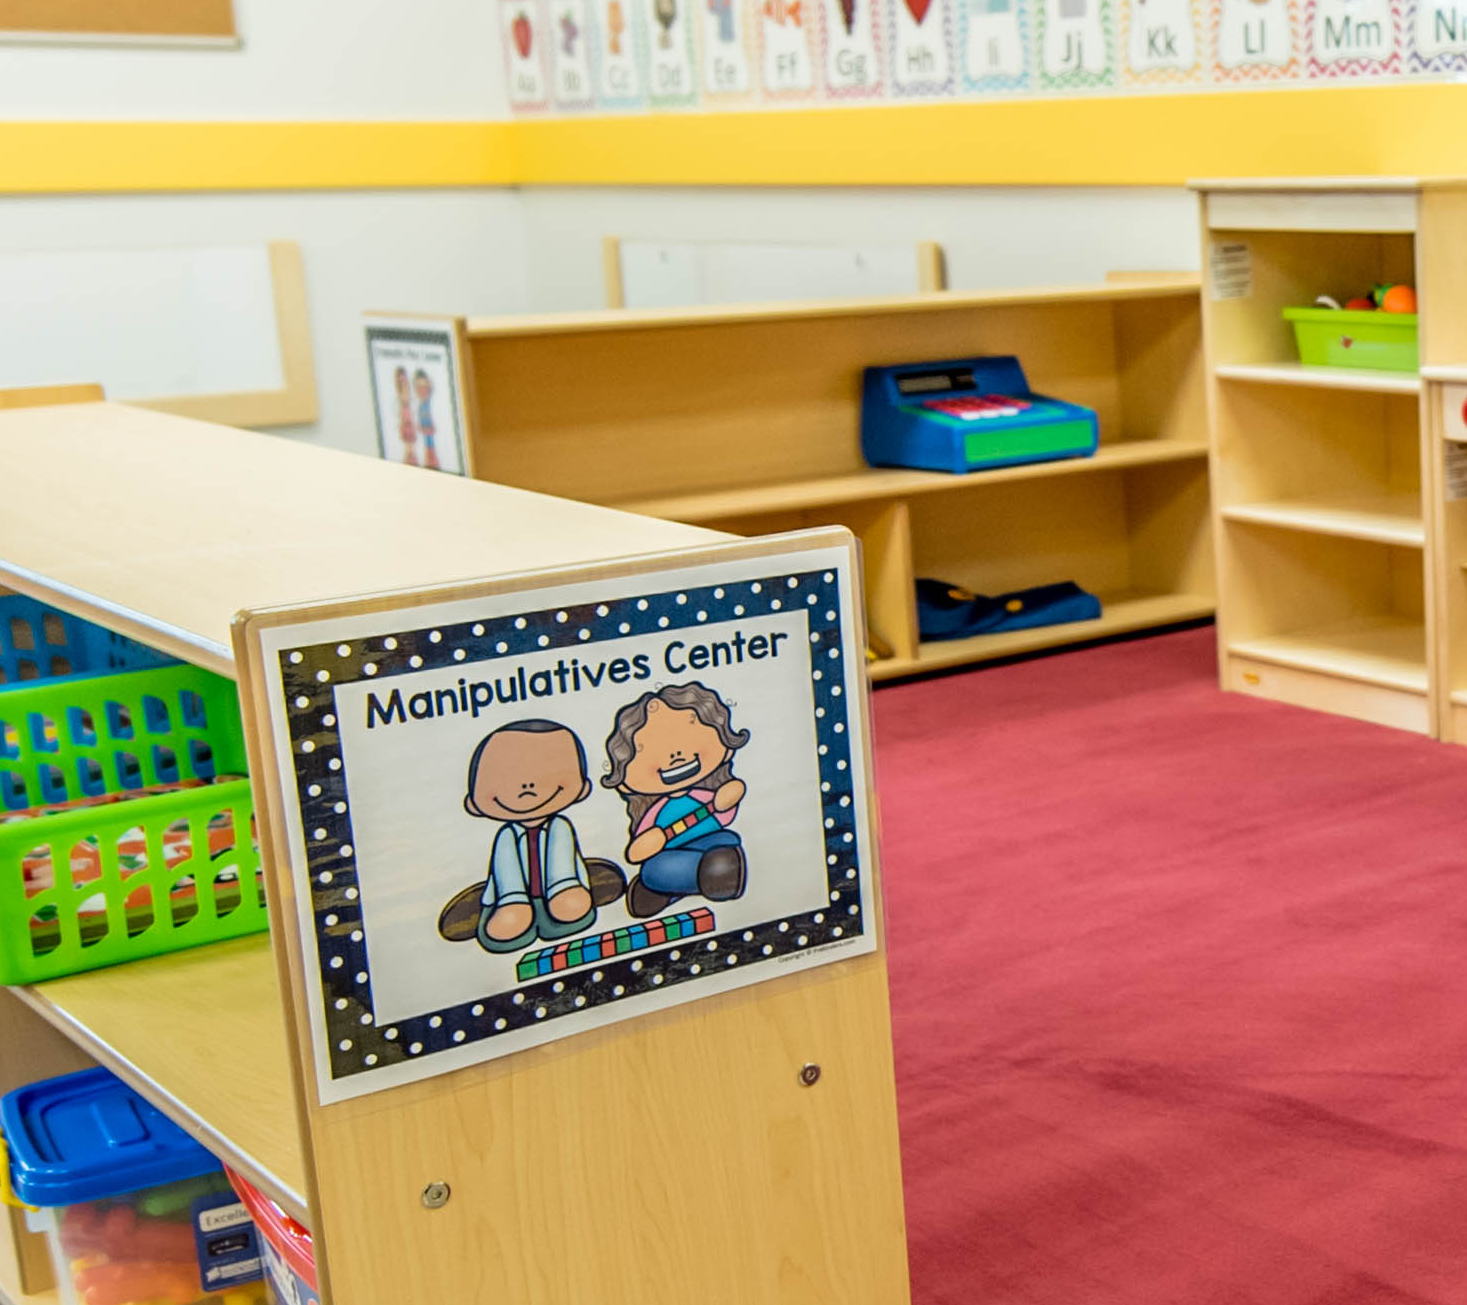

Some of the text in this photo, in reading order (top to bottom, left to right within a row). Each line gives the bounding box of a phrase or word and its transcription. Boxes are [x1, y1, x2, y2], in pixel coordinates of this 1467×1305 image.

[1147, 25, 1177, 58] Kk
[1244, 19, 1265, 54] Ll
[1324, 15, 1381, 50] Mm
[776, 51, 797, 81] Ff
[906, 44, 932, 72] Hh
[1062, 31, 1083, 68] Jj
[607, 64, 630, 90] Cc
[658, 62, 682, 88] Dd
[713, 57, 735, 85] Ee
[836, 48, 867, 86] Gg
[366, 626, 789, 729] Manipulatives Center
